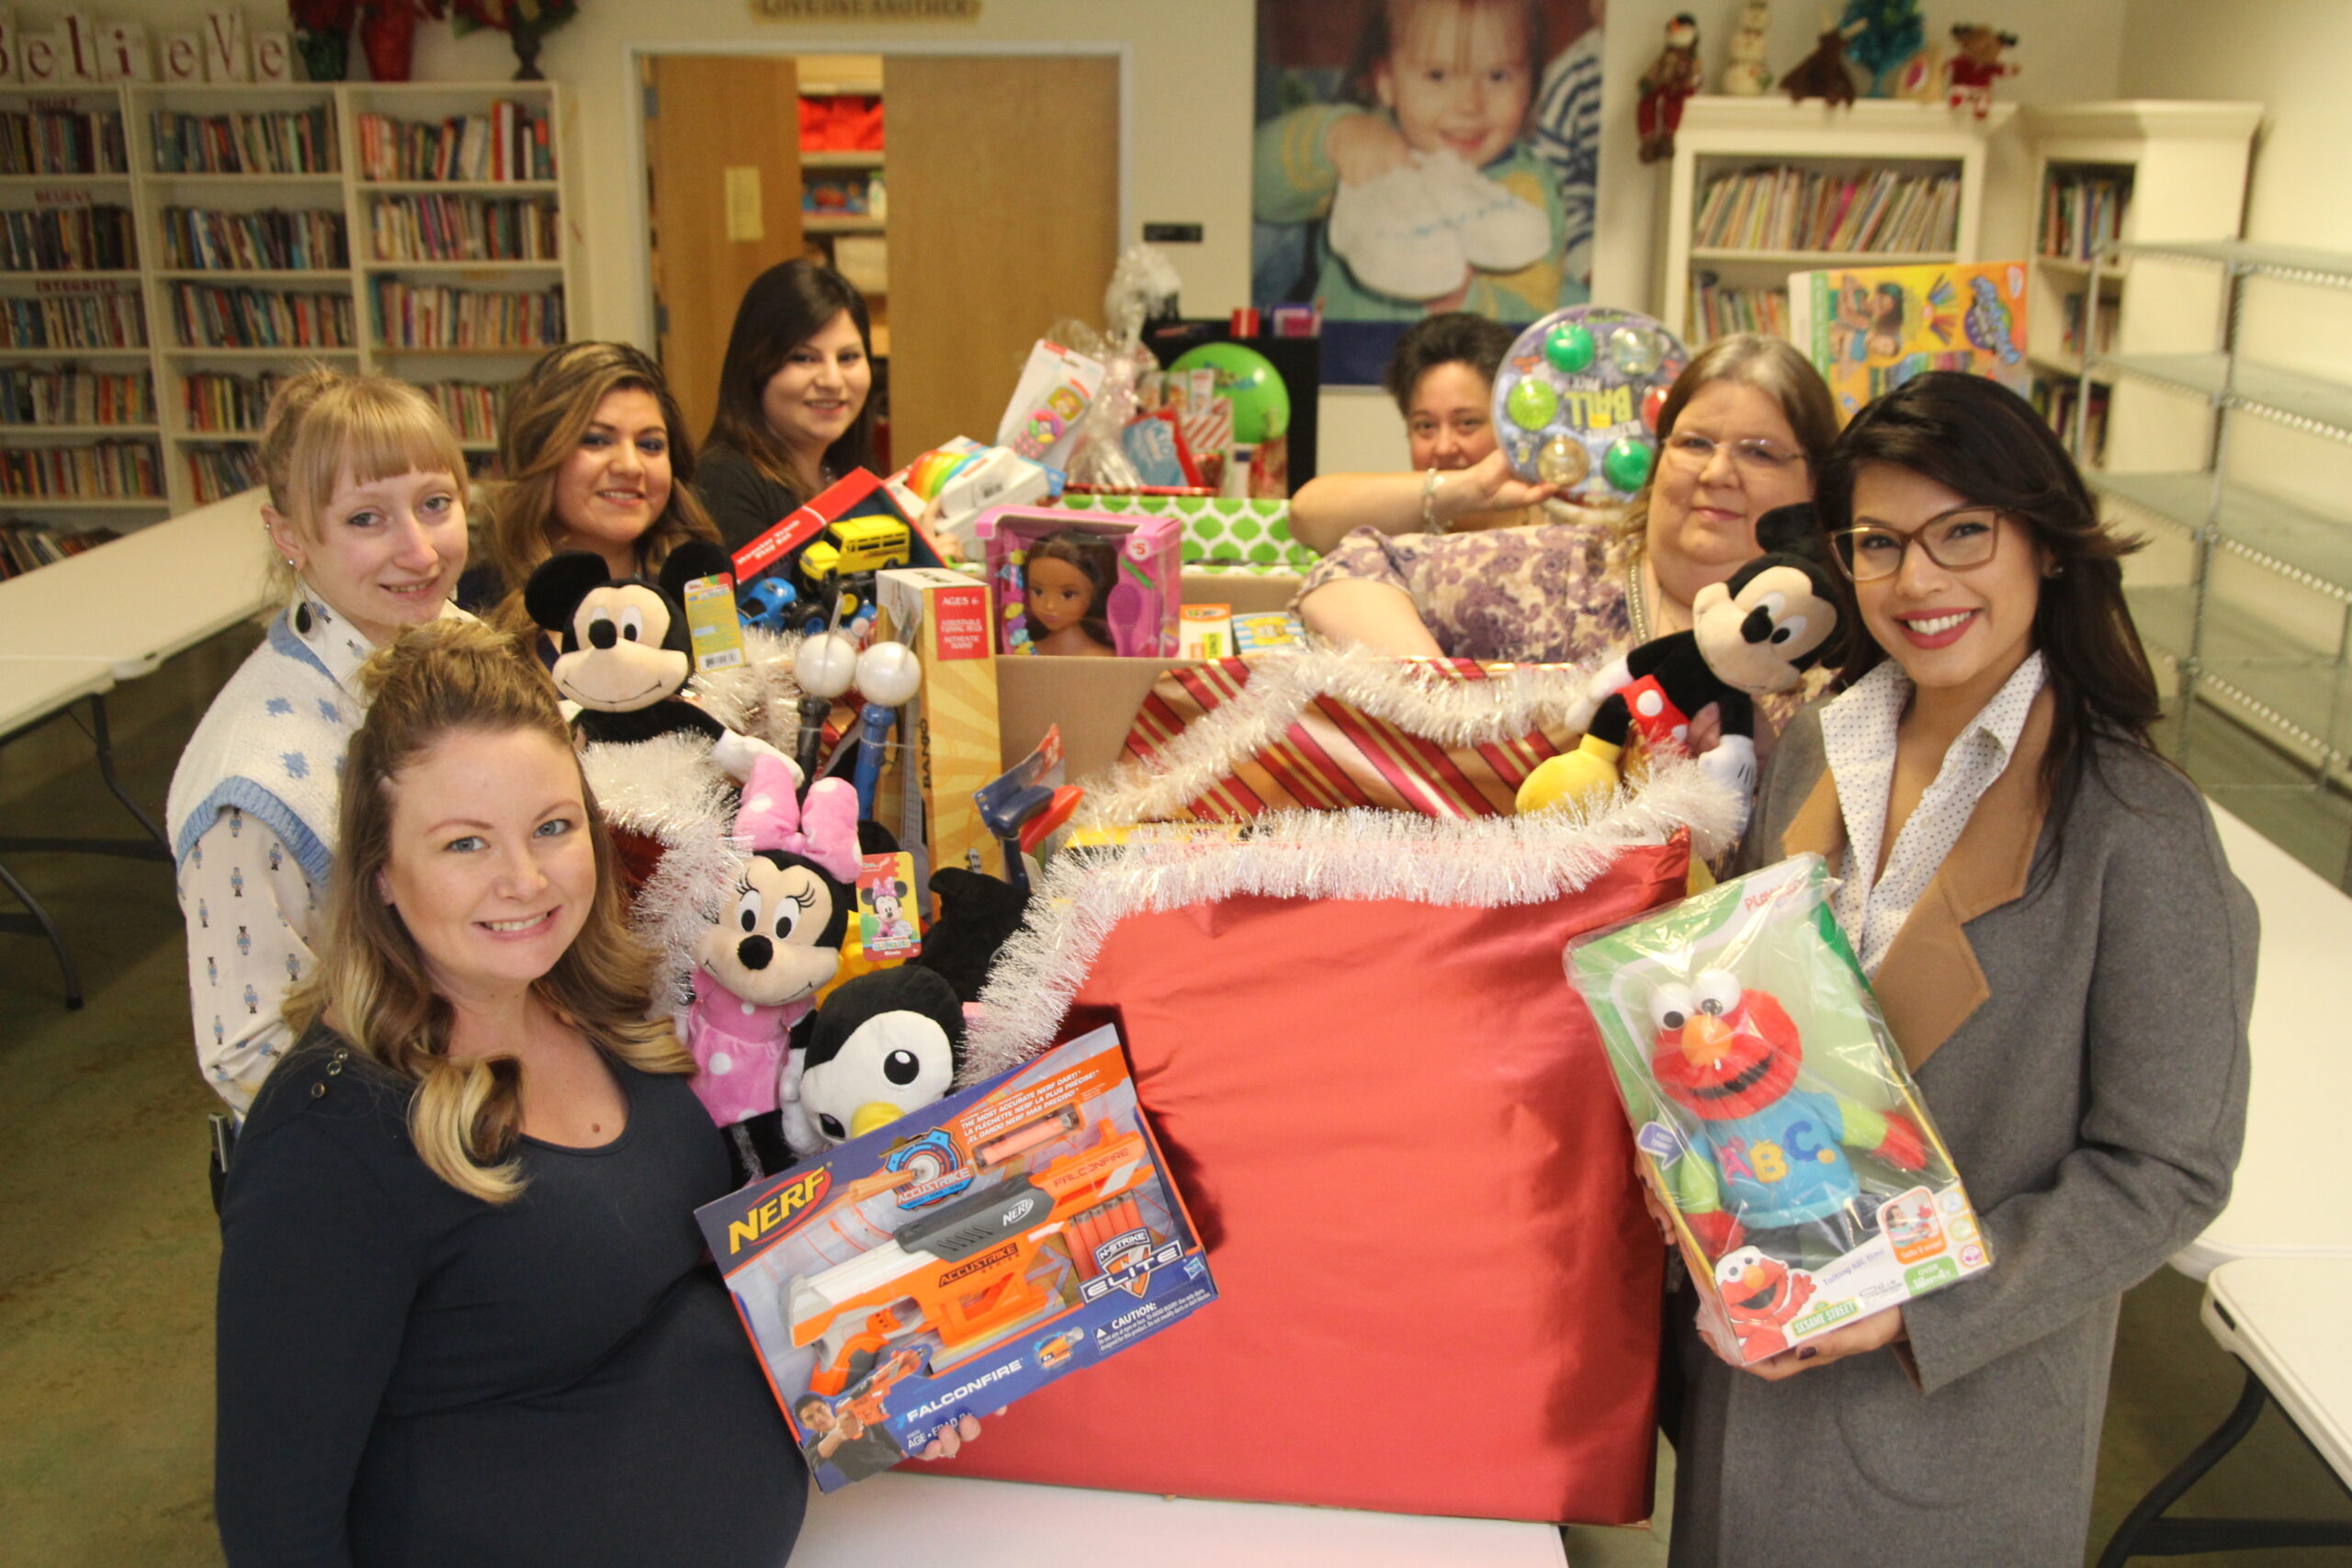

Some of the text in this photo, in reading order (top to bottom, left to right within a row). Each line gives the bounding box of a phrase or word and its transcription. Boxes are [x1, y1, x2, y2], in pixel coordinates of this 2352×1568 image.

[1565, 384, 1633, 429] BALL
[943, 596, 968, 605] AGES
[920, 718, 932, 788] BANJO
[961, 1120, 975, 1129] THE
[977, 1109, 998, 1122] MOST
[999, 1092, 1035, 1111] ACCURATE
[1036, 1082, 1056, 1095] NERF
[964, 1127, 974, 1136] LA
[1015, 1102, 1034, 1114] NERF
[1035, 1095, 1045, 1104] LA
[1046, 1087, 1064, 1100] PLUS
[979, 1122, 1004, 1138] DARDO
[1006, 1113, 1024, 1126] NERF
[1054, 1148, 1130, 1188] FALCONFIRE
[728, 1166, 825, 1256] NERF
[1002, 1198, 1035, 1227] NERF
[939, 1242, 1019, 1288] ACCUSTRIKE
[1099, 1232, 1147, 1260] N-STRIKE
[1087, 1247, 1178, 1297] ELITE
[1112, 1302, 1157, 1329] CAUTION:
[1794, 1302, 1855, 1335] SESAME STREET
[907, 1359, 1023, 1423] FALCONFIRE
[908, 1433, 927, 1450] AGE
